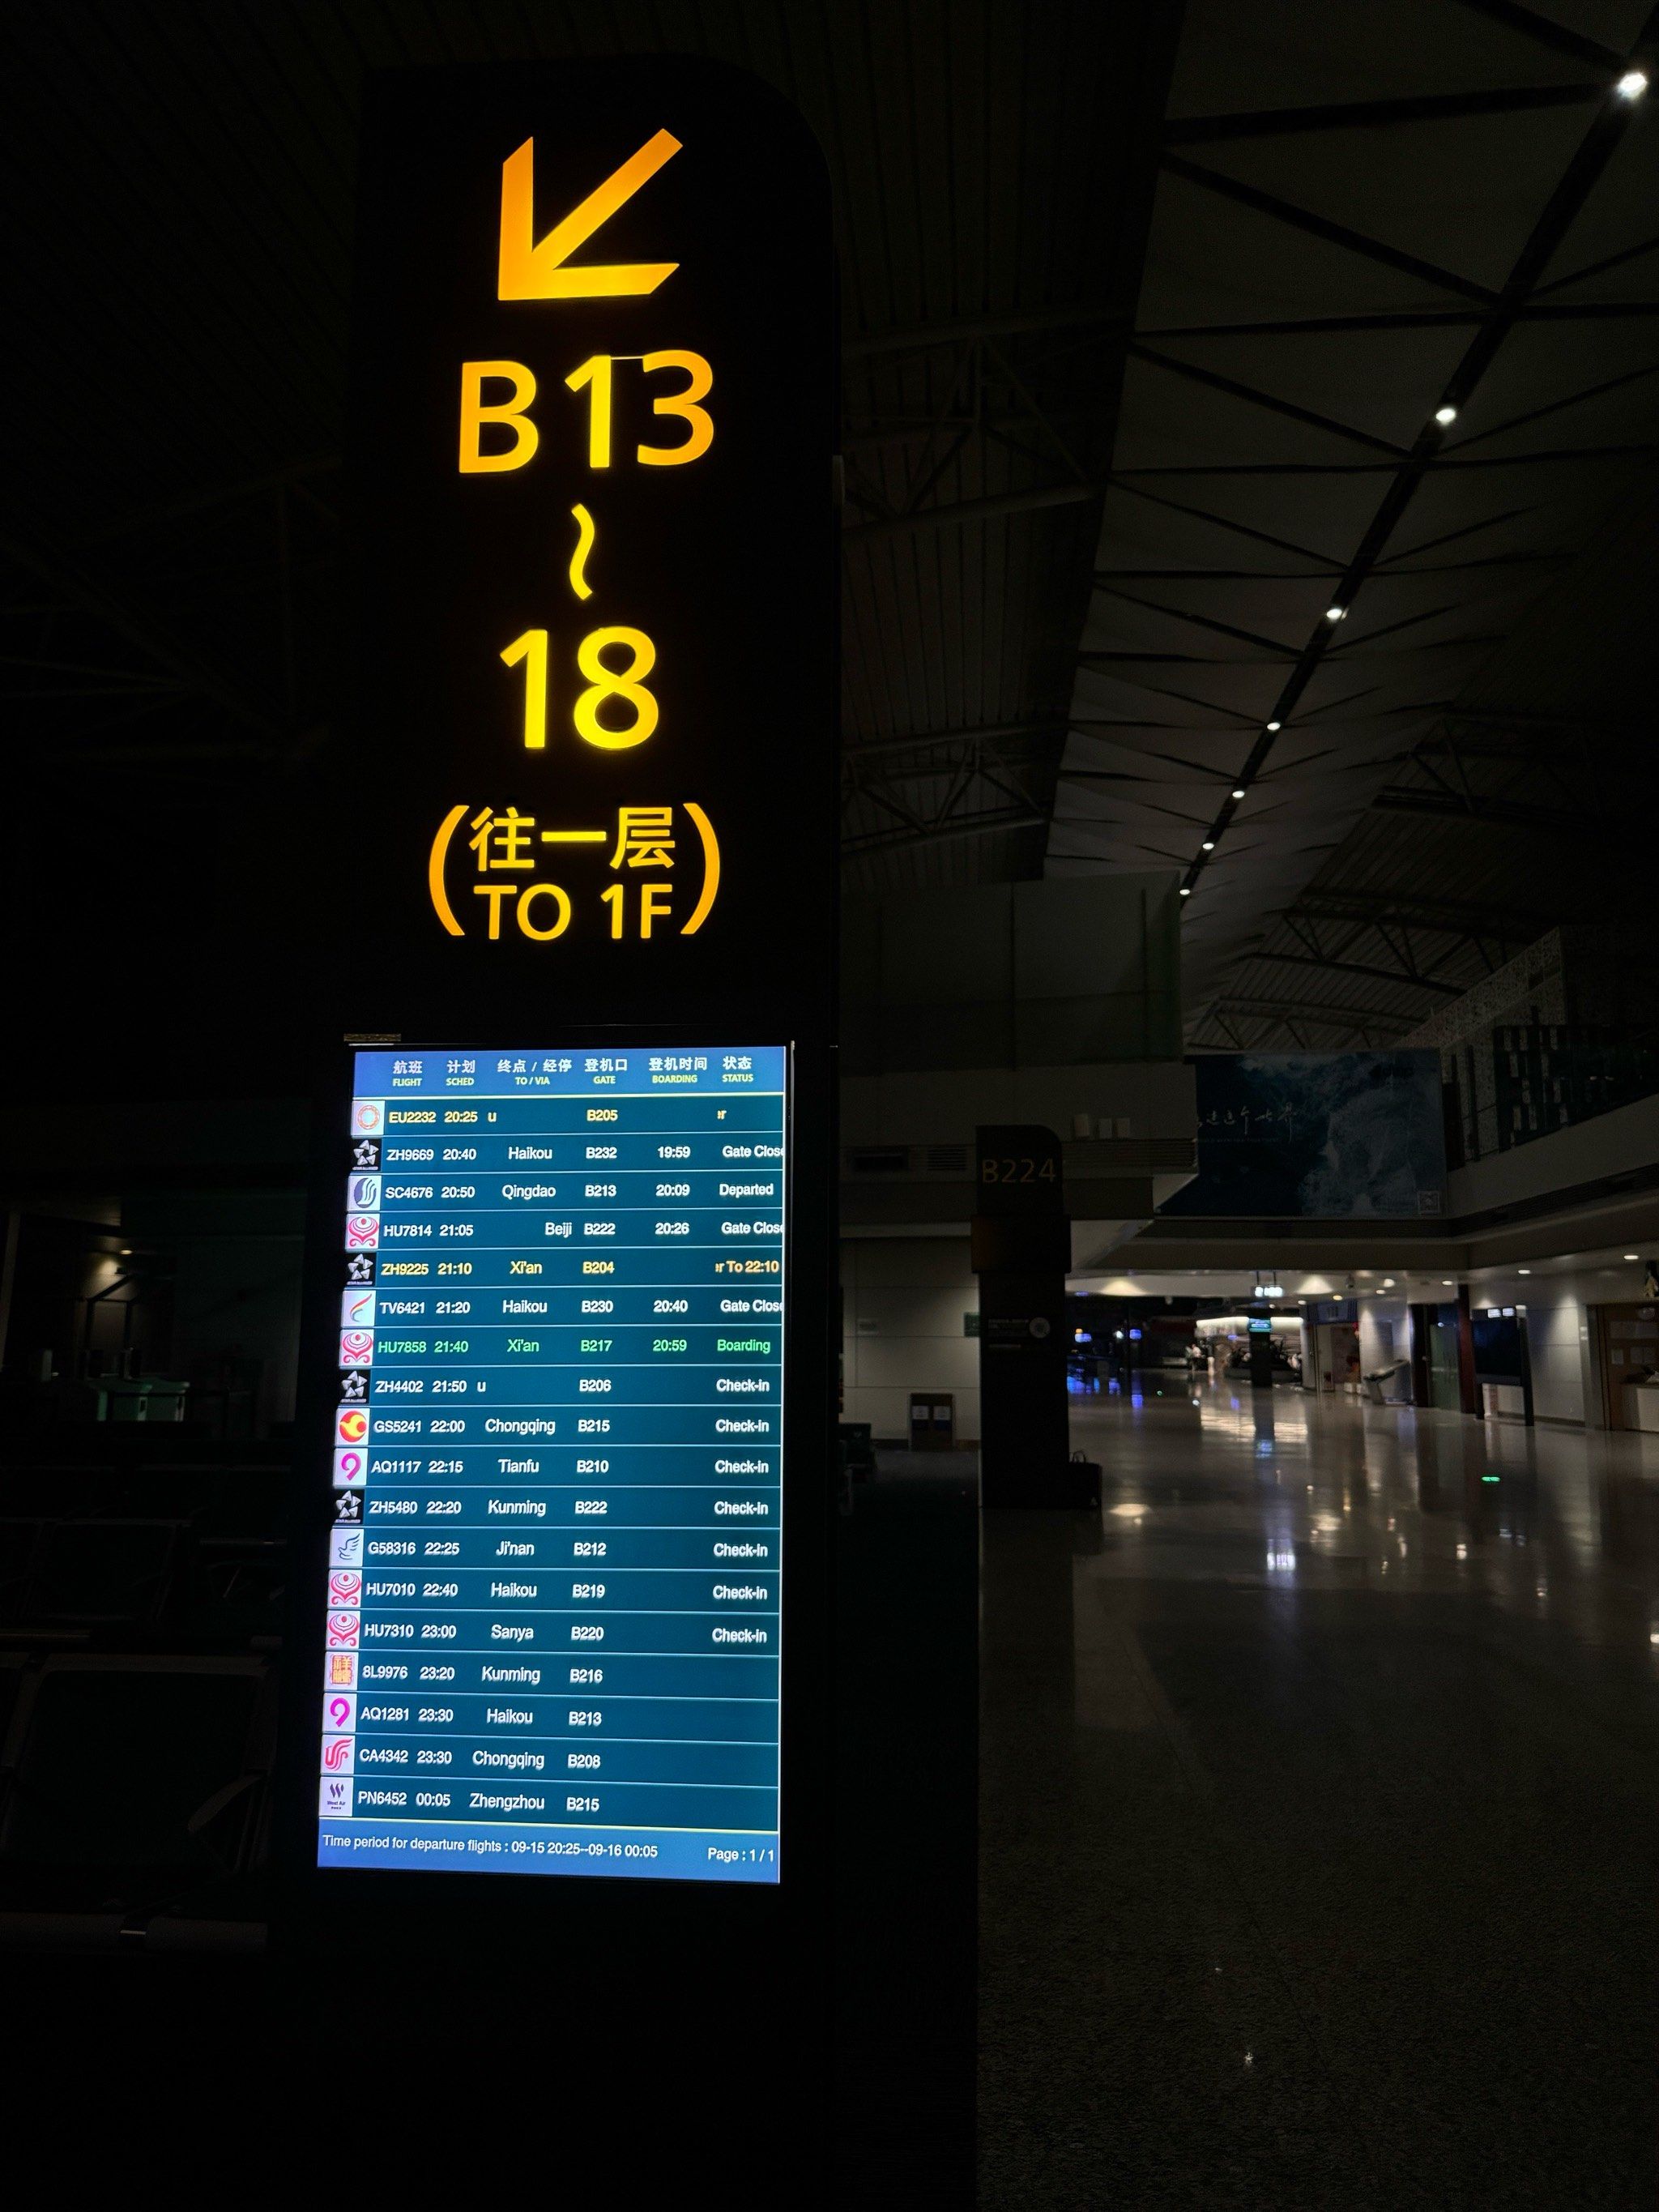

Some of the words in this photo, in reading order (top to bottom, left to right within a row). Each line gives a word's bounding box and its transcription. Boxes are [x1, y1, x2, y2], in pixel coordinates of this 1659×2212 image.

[459, 350, 714, 473] B13
[501, 626, 659, 750] 18
[474, 884, 571, 940] TO
[600, 884, 672, 938] 1F
[393, 1061, 422, 1074] 航班
[447, 1060, 475, 1073] 计划
[497, 1059, 526, 1073] 终点
[531, 1062, 537, 1071] /
[544, 1059, 572, 1072] 经停
[585, 1058, 627, 1072] 登机口
[649, 1057, 707, 1071] 登机时间
[723, 1056, 752, 1070] 状态
[393, 1078, 422, 1087] FLIGHT
[446, 1078, 474, 1086] SCHED
[515, 1077, 527, 1085] TO
[535, 1077, 550, 1085] VIA
[652, 1074, 697, 1083] BOARDING
[723, 1074, 753, 1082] STATUS
[389, 1112, 436, 1123] EU2232
[445, 1111, 478, 1122] 20:25
[488, 1112, 497, 1122] u
[587, 1109, 618, 1121] B205
[386, 1149, 433, 1160] ZH9669
[443, 1149, 476, 1159] 20:40
[509, 1147, 552, 1159] Haikou
[586, 1147, 617, 1159] B232
[658, 1147, 690, 1158] 19:59
[723, 1146, 752, 1157] Gate
[982, 1158, 1056, 1184] B224
[386, 1187, 433, 1198] SC4676
[441, 1186, 475, 1198] 20:50
[502, 1185, 556, 1200] Qingdao
[585, 1185, 616, 1197] B213
[656, 1184, 690, 1196] 20:09
[719, 1183, 774, 1198] Departed
[384, 1225, 432, 1236] HU7814
[440, 1224, 473, 1236] 21:05
[584, 1223, 616, 1235] B222
[655, 1223, 689, 1235] 20:26
[722, 1222, 751, 1234] Gate
[381, 1263, 429, 1275] ZH9225
[438, 1263, 472, 1275] 21:10
[510, 1261, 542, 1274] Xi'an
[583, 1262, 615, 1274] B204
[726, 1261, 743, 1272] To
[745, 1261, 779, 1272] 22:10
[379, 1302, 424, 1314] TV6421
[436, 1302, 470, 1313] 21:20
[503, 1300, 547, 1313] Haikou
[582, 1300, 613, 1313] B230
[654, 1300, 688, 1313] 20:40
[720, 1300, 750, 1312] Gate
[378, 1341, 426, 1353] HU7858
[434, 1341, 468, 1352] 21:40
[507, 1339, 539, 1352] Xi'an
[581, 1340, 612, 1352] B217
[653, 1339, 687, 1352] 20:59
[718, 1339, 770, 1354] Boarding
[375, 1381, 423, 1393] ZH4402
[432, 1381, 467, 1392] 21:50
[477, 1382, 486, 1392] u
[579, 1380, 611, 1391] B206
[716, 1379, 770, 1392] Check-in
[373, 1420, 421, 1433] GS5241
[430, 1420, 465, 1433] 22:00
[485, 1419, 555, 1435] Chongqing
[578, 1420, 610, 1432] B215
[715, 1420, 769, 1432] Check-in
[371, 1461, 421, 1473] AQ1117
[429, 1461, 463, 1473] 22:15
[498, 1459, 539, 1472] Tianfu
[577, 1460, 608, 1473] B210
[715, 1460, 769, 1473] Check-in
[369, 1501, 417, 1514] ZH5480
[426, 1501, 461, 1514] 22:20
[488, 1500, 546, 1517] Kunming
[575, 1501, 608, 1514] B222
[714, 1501, 768, 1514] Check-in
[368, 1542, 416, 1555] G58316
[424, 1543, 459, 1555] 22:25
[496, 1541, 534, 1555] Ji'nan
[574, 1543, 606, 1556] B212
[714, 1543, 768, 1557] Check-in
[366, 1582, 416, 1596] HU7010
[423, 1583, 458, 1596] 22:40
[491, 1582, 537, 1597] Haikou
[573, 1584, 605, 1598] B219
[713, 1586, 767, 1599] Check-in
[365, 1624, 414, 1638] HU7310
[421, 1625, 456, 1638] 23:00
[491, 1625, 533, 1642] Sanya
[571, 1626, 603, 1640] B220
[712, 1628, 766, 1642] Check-in
[362, 1666, 407, 1679] 8L9976
[420, 1667, 454, 1680] 23:20
[482, 1666, 540, 1685] Kunming
[570, 1669, 603, 1683] B216
[360, 1707, 408, 1720] AQ1281
[419, 1709, 453, 1722] 23:30
[487, 1709, 532, 1724] Haikou
[569, 1711, 602, 1726] B213
[360, 1749, 408, 1762] CA4342
[417, 1751, 452, 1764] 23:30
[473, 1751, 544, 1770] Chongqing
[568, 1754, 600, 1769] B208
[358, 1791, 407, 1805] PN6452
[416, 1793, 450, 1807] 00:05
[470, 1793, 544, 1812] Zhengzhou
[567, 1797, 599, 1812] B215
[322, 1835, 351, 1847] Time
[354, 1837, 389, 1849] period
[392, 1837, 407, 1848] for
[410, 1838, 465, 1852] departure
[467, 1839, 501, 1854] flights
[505, 1843, 508, 1852] :
[511, 1841, 544, 1853] 09-15
[625, 1845, 658, 1857] 00:05
[708, 1847, 739, 1863] Page
[742, 1851, 745, 1861] :
[750, 1849, 755, 1861] 1
[759, 1849, 765, 1861] /
[769, 1850, 773, 1861] 1
